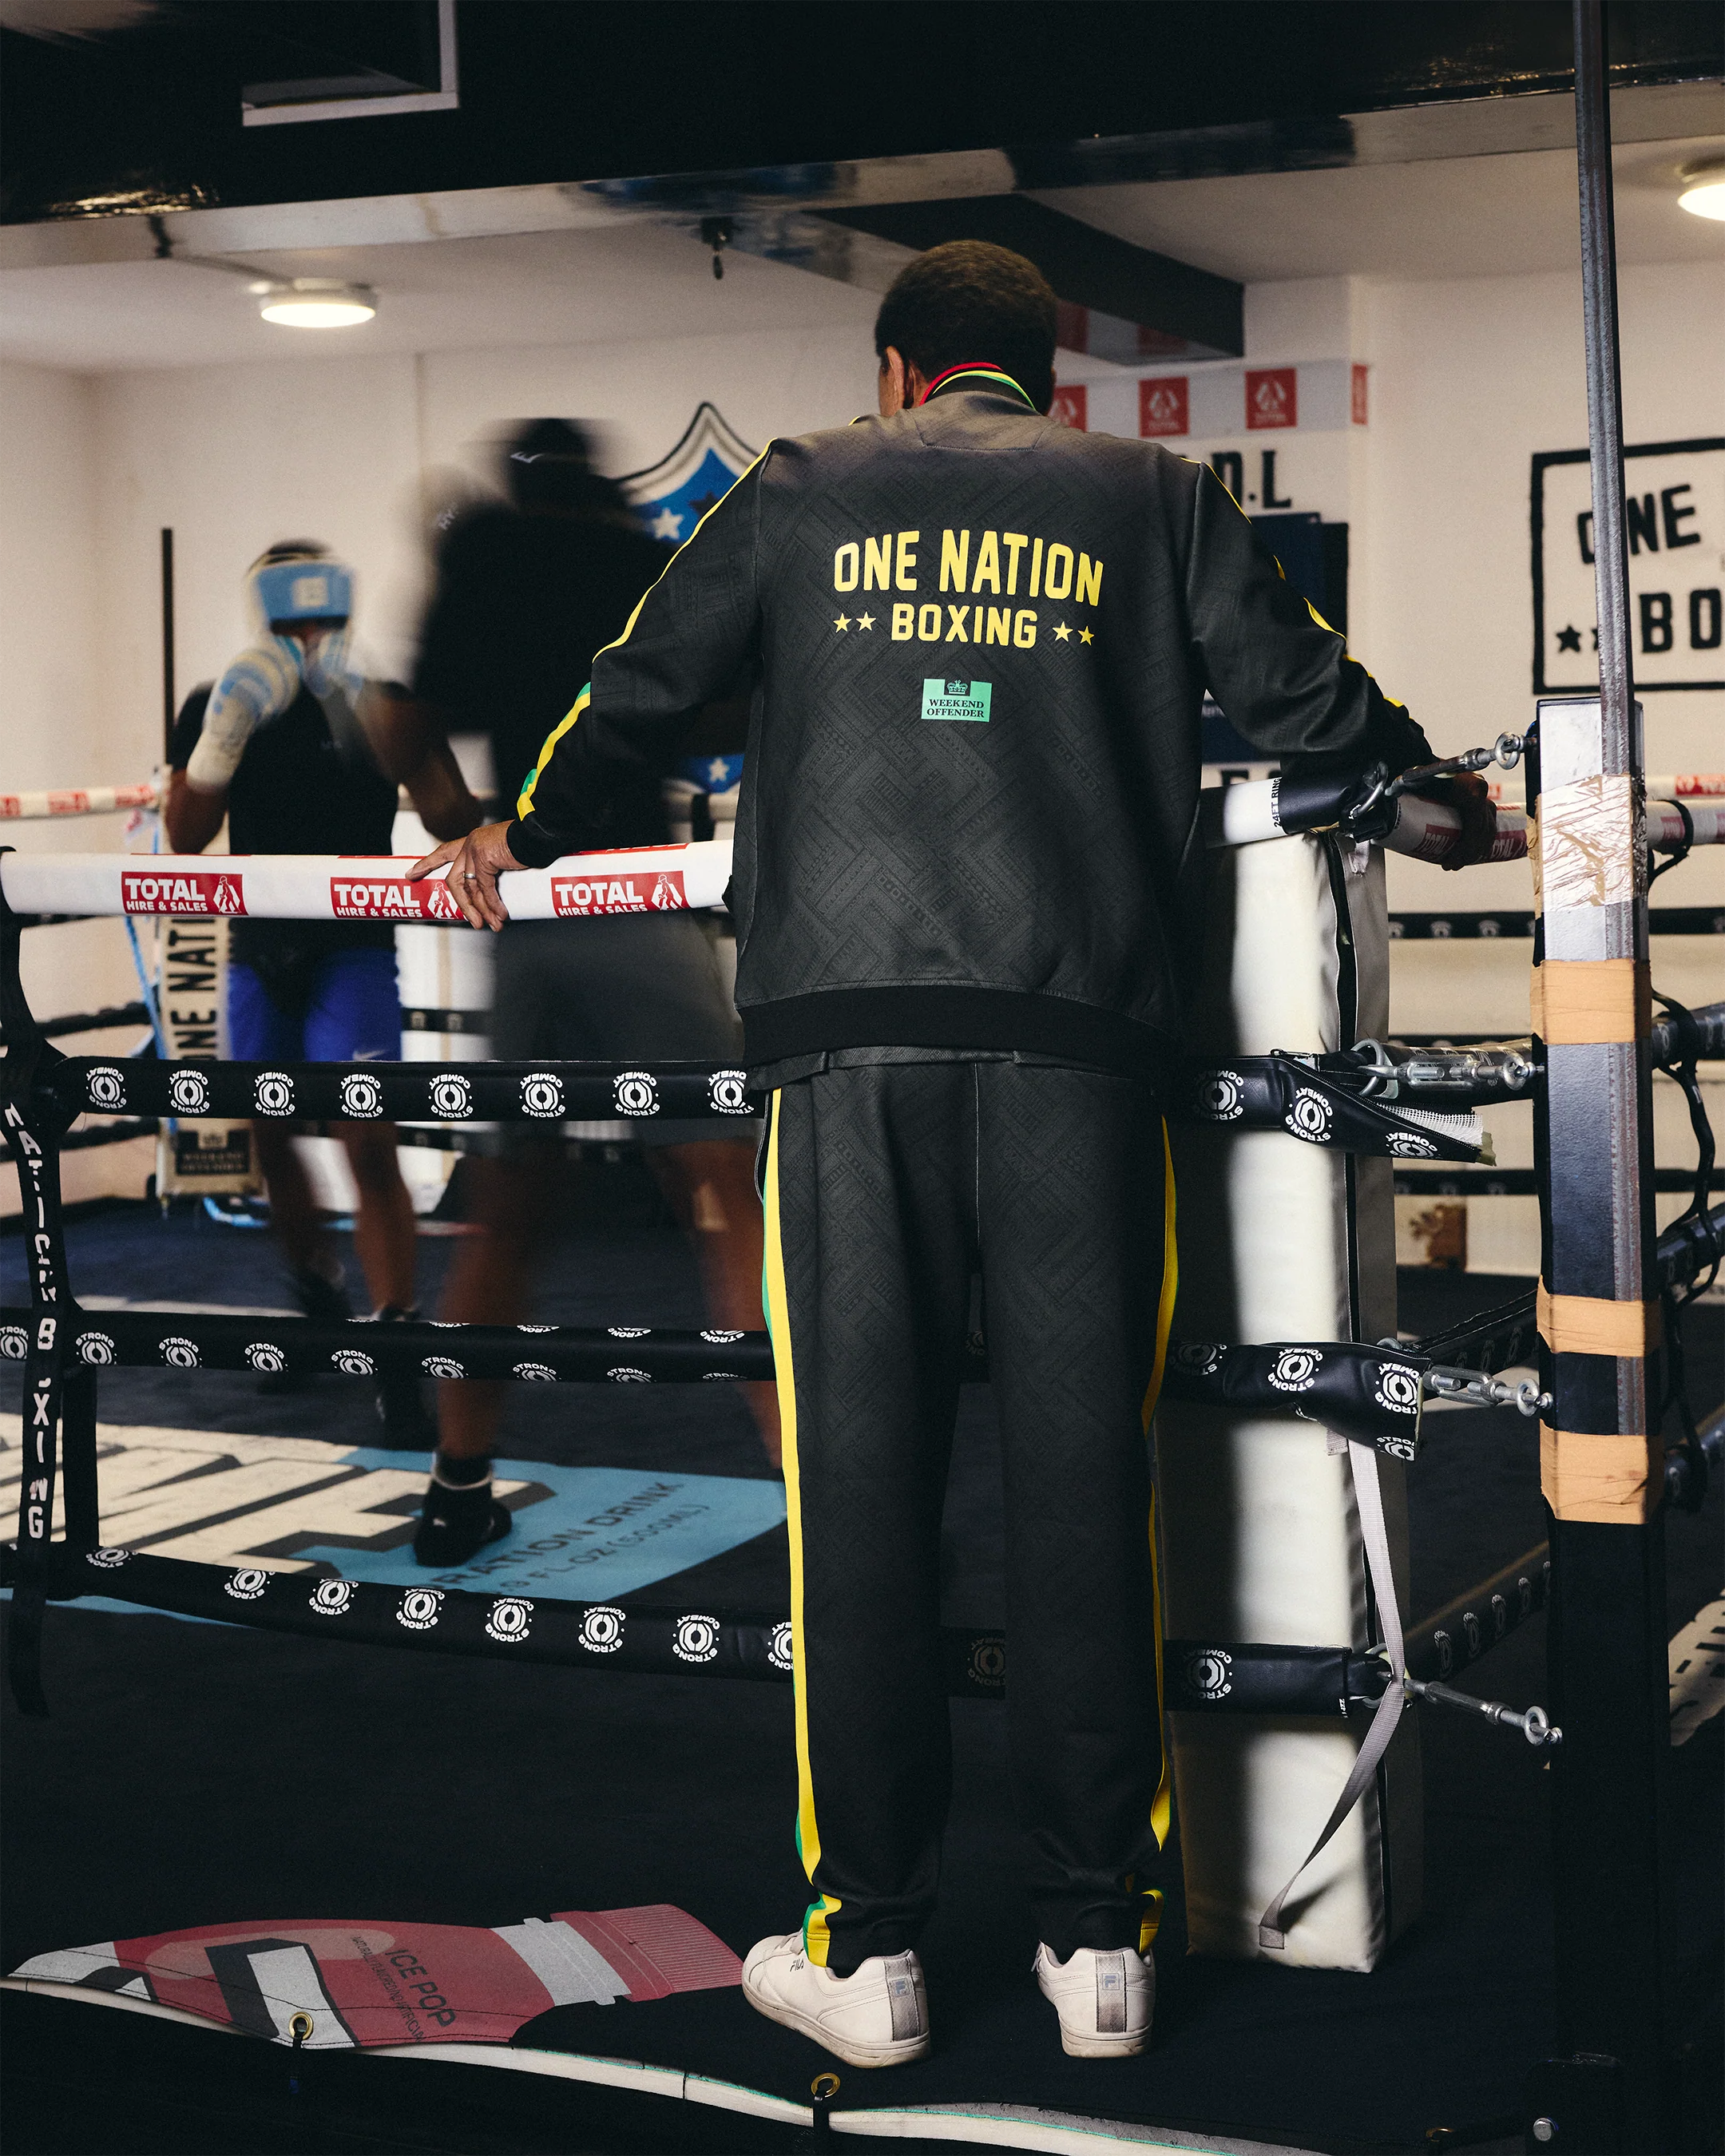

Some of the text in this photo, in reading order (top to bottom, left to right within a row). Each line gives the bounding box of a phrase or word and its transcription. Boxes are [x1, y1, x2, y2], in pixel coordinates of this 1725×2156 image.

[834, 529, 1104, 606] ONE NATION
[891, 603, 1037, 648] BOXING
[929, 699, 984, 708] WEEKEND
[926, 708, 984, 718] OFFENDER
[125, 878, 205, 901] TOTAL
[334, 884, 420, 907] TOTAL
[555, 881, 644, 906] TOTAL
[126, 901, 208, 912] HIRE & SALES
[336, 907, 422, 918] HIRE & SALES
[558, 906, 590, 916] HIRE
[605, 904, 648, 914] SALES
[86, 1067, 125, 1082] COMBAT
[169, 1069, 208, 1086] COMBAT
[255, 1072, 294, 1088] COMBAT
[340, 1074, 382, 1090] COMBAT
[429, 1074, 471, 1090] COMBAT
[520, 1072, 563, 1089] COMBAT
[613, 1072, 657, 1088] COMBAT
[708, 1070, 747, 1087] OMBAT
[89, 1096, 126, 1108] STRONG
[170, 1099, 210, 1114] STRONG
[255, 1101, 295, 1116] STRONG
[1295, 1087, 1333, 1116] COMBAT
[341, 1104, 383, 1118] STRONG
[430, 1104, 474, 1118] STRONG
[521, 1104, 565, 1118] STRONG
[615, 1102, 660, 1118] STRONG
[1285, 1114, 1331, 1142] STRONG
[0, 1326, 28, 1341] TRON
[76, 1333, 114, 1349] STRONG
[159, 1338, 199, 1353] STRONG
[244, 1343, 284, 1359] STRONG
[331, 1349, 375, 1365] STRONG
[1279, 1348, 1323, 1361] COMBAT
[421, 1357, 464, 1371] STRONG
[512, 1363, 557, 1377] STRONG
[1378, 1362, 1420, 1384] OMBAT
[1267, 1372, 1315, 1392] STRONG
[224, 1583, 265, 1599] STRONG
[309, 1597, 351, 1615] STRONG
[492, 1598, 534, 1611] COMBAT
[395, 1611, 439, 1630] STRONG
[583, 1606, 626, 1621] COMBAT
[676, 1614, 720, 1631] COMBAT
[485, 1623, 530, 1643] STRONG
[578, 1633, 623, 1653] STRONG
[672, 1643, 718, 1663] STRONG
[790, 1958, 804, 1972] FILA
[385, 1949, 456, 2027] ICE POP
